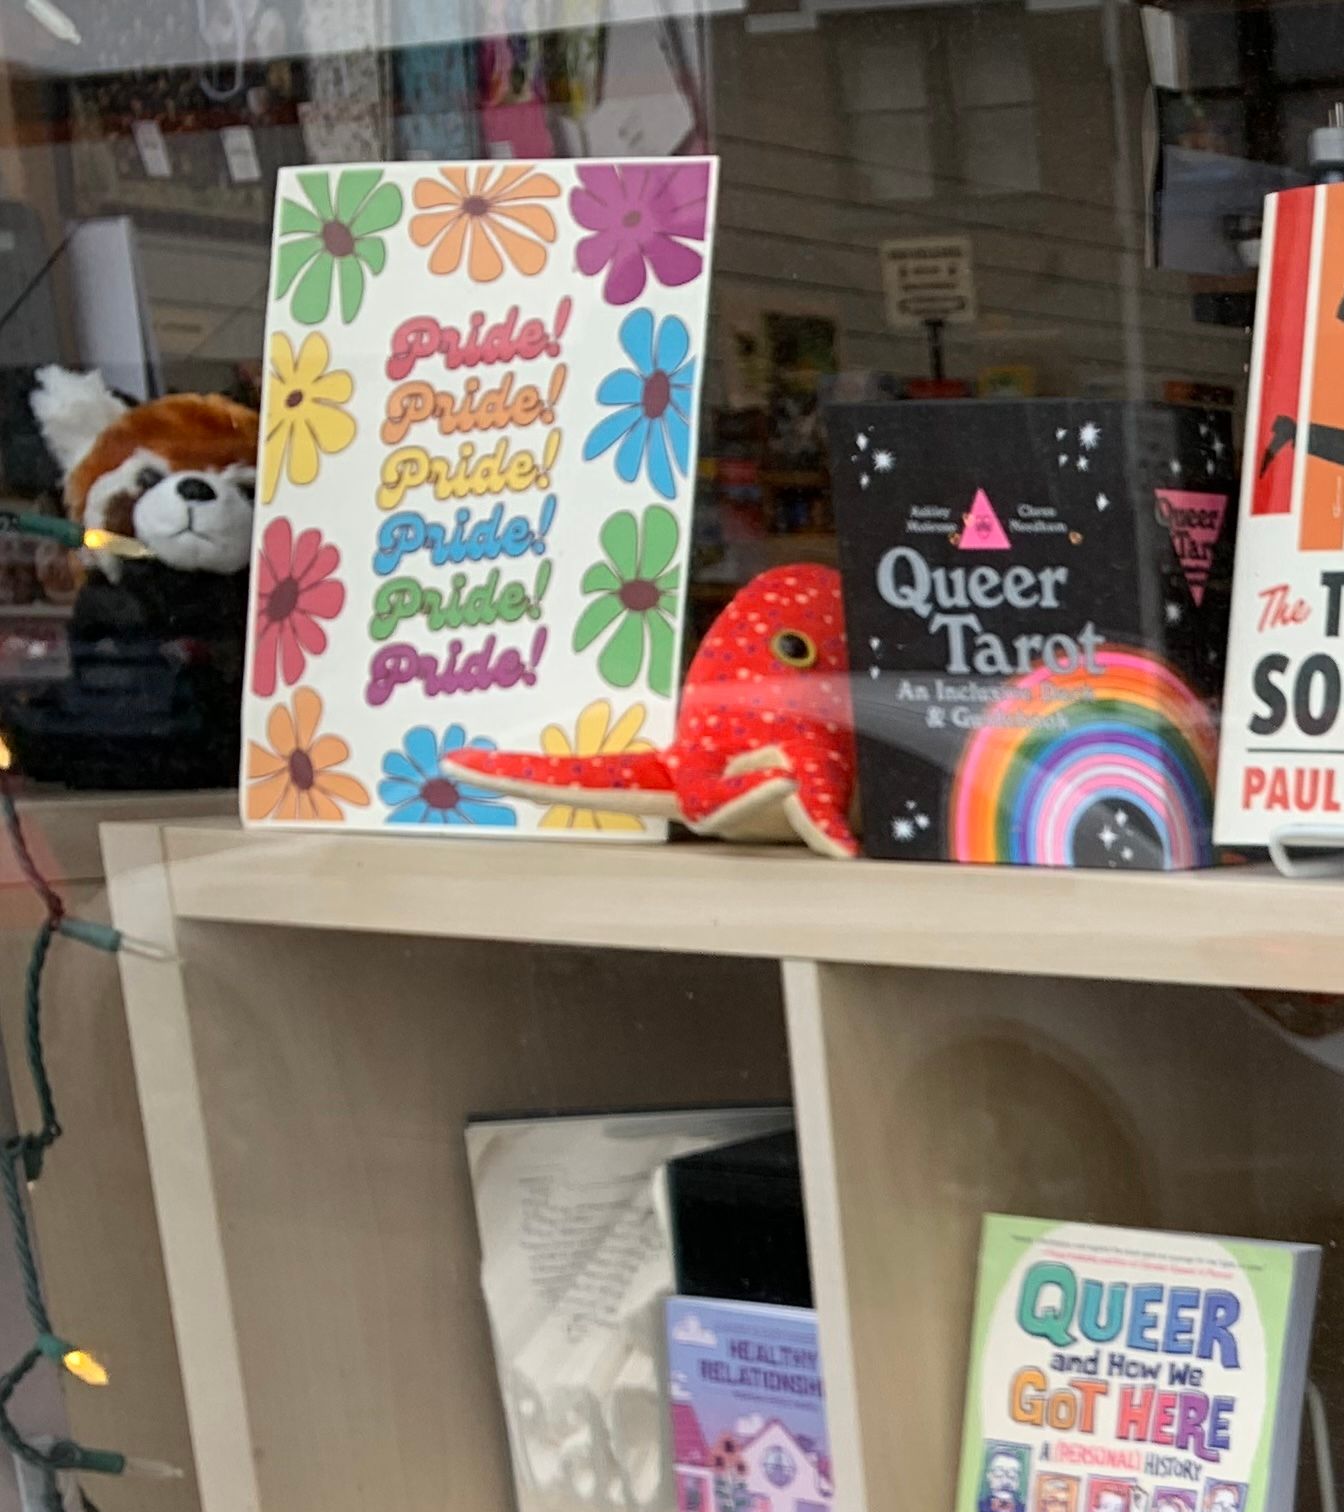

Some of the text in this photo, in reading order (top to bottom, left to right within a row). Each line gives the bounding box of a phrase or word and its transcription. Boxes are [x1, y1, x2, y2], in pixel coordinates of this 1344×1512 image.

[385, 295, 573, 380] Pride!
[380, 363, 567, 444] Pride!
[377, 430, 562, 510] Pride!
[373, 494, 557, 576] Pride!
[369, 559, 553, 641] Pride!
[877, 546, 1068, 617] Queer
[1257, 584, 1310, 633] The
[365, 626, 548, 707] Pride!
[930, 613, 1105, 674] Tarot
[1243, 766, 1340, 813] PAUL
[1017, 1261, 1240, 1368] QUEER
[1050, 1350, 1098, 1377] and
[1116, 1384, 1237, 1462] HERE
